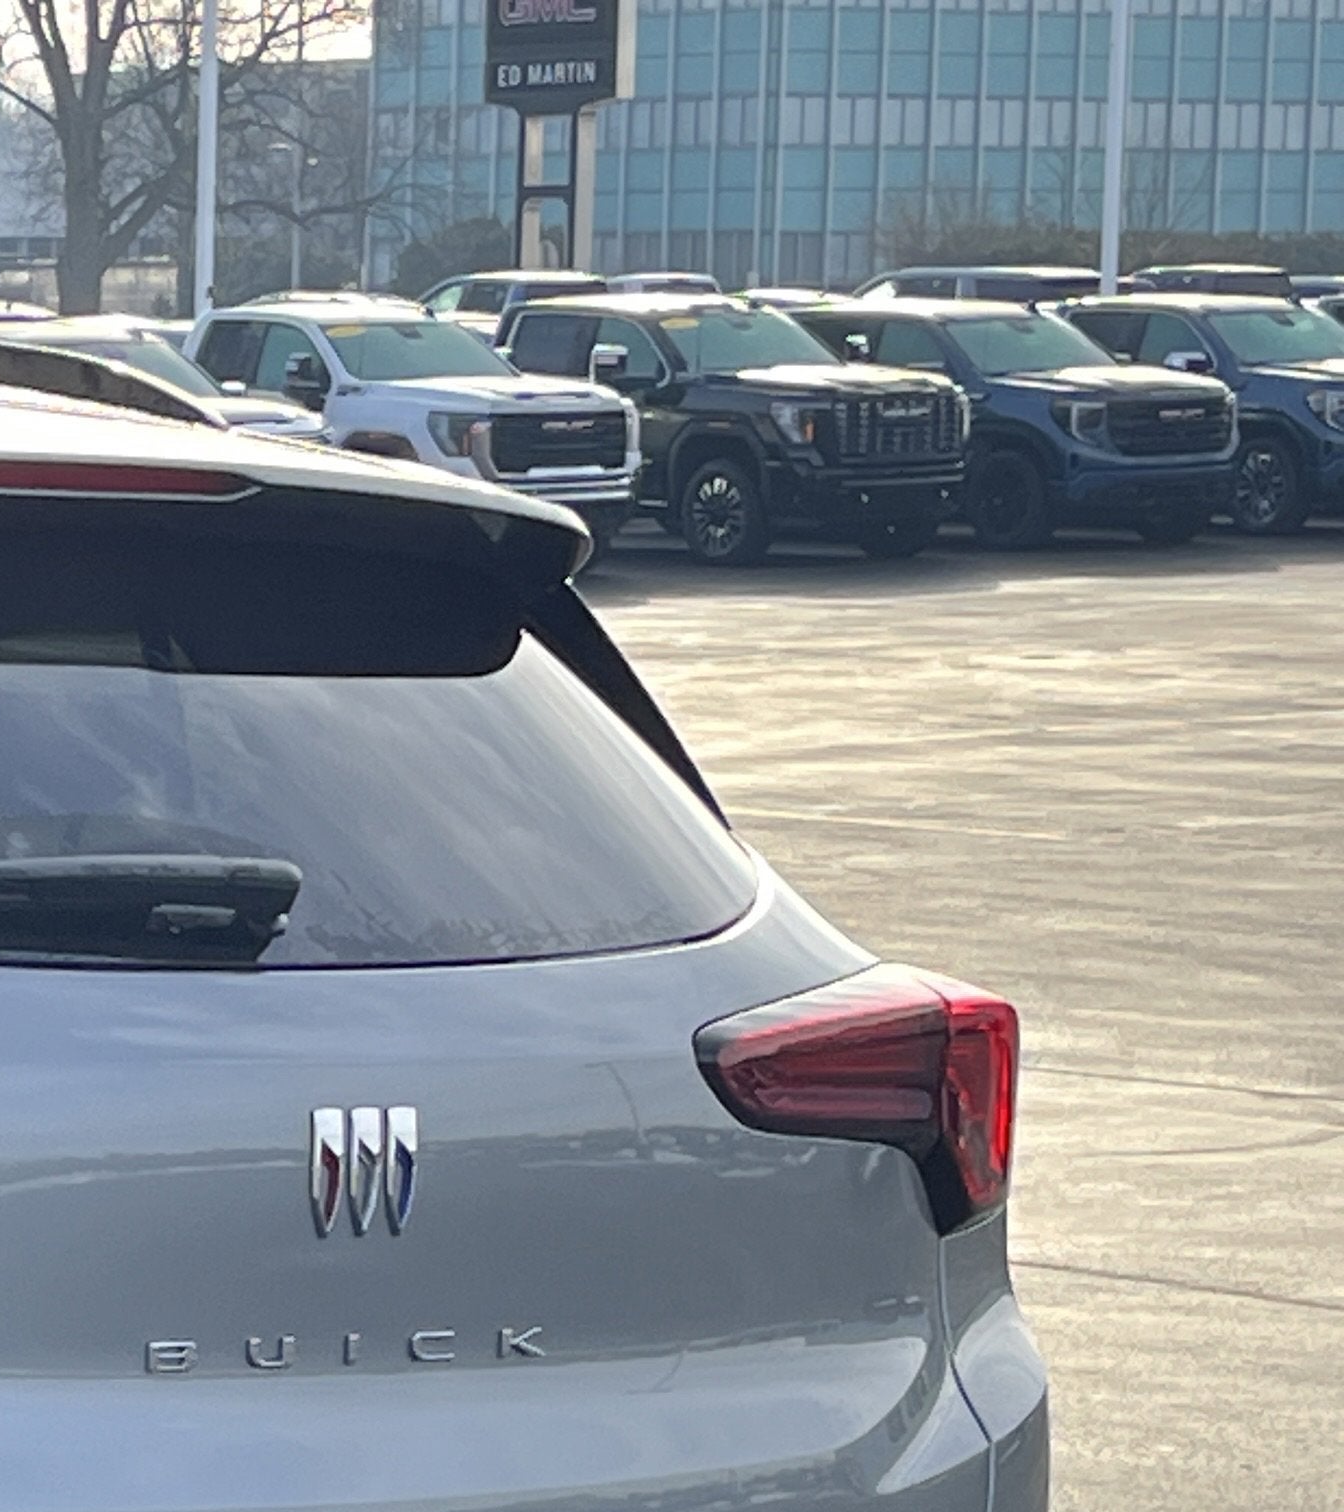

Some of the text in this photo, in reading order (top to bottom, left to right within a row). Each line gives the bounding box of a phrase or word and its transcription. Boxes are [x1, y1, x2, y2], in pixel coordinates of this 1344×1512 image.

[497, 61, 596, 88] ED MARTIN
[145, 1325, 547, 1375] BUICK
